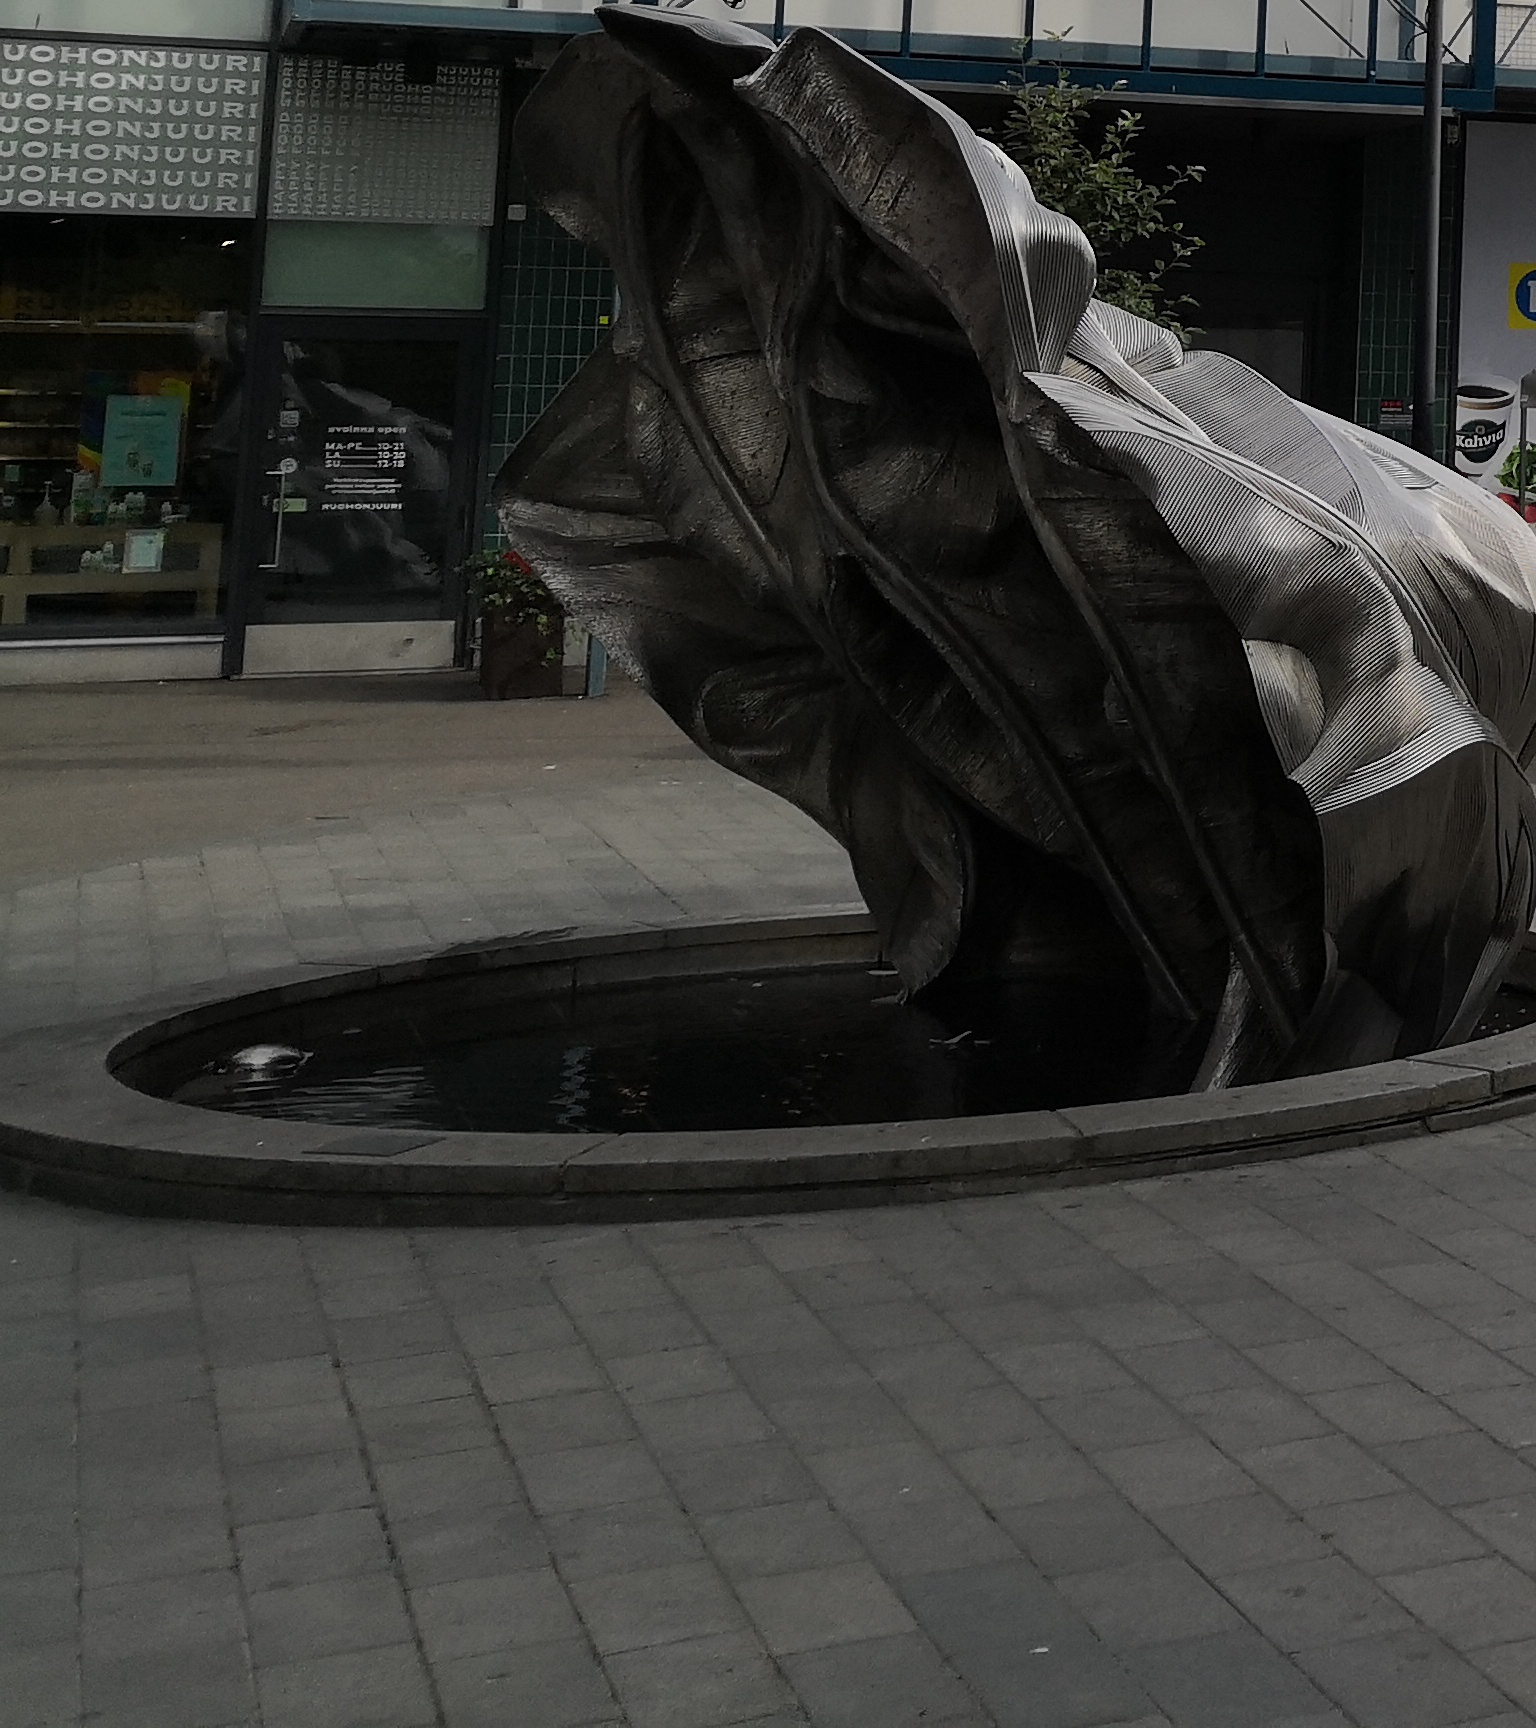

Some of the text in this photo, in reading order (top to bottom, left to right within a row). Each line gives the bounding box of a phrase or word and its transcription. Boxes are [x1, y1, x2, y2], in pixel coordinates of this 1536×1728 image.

[3, 43, 262, 73] UOHONJUURI
[1, 68, 260, 97] UOHONJUURI
[0, 92, 258, 120] UOHONJUURI
[0, 116, 257, 143] UOHONJUURI
[273, 56, 293, 214] HAPPY FOOD STORE
[292, 113, 304, 154] FOOD
[288, 159, 301, 214] HAPPY
[376, 426, 406, 435] open
[1456, 429, 1504, 449] Kahvia
[324, 459, 341, 467] SU
[325, 450, 341, 458] LA
[321, 502, 402, 510] RUOHONJUURI
